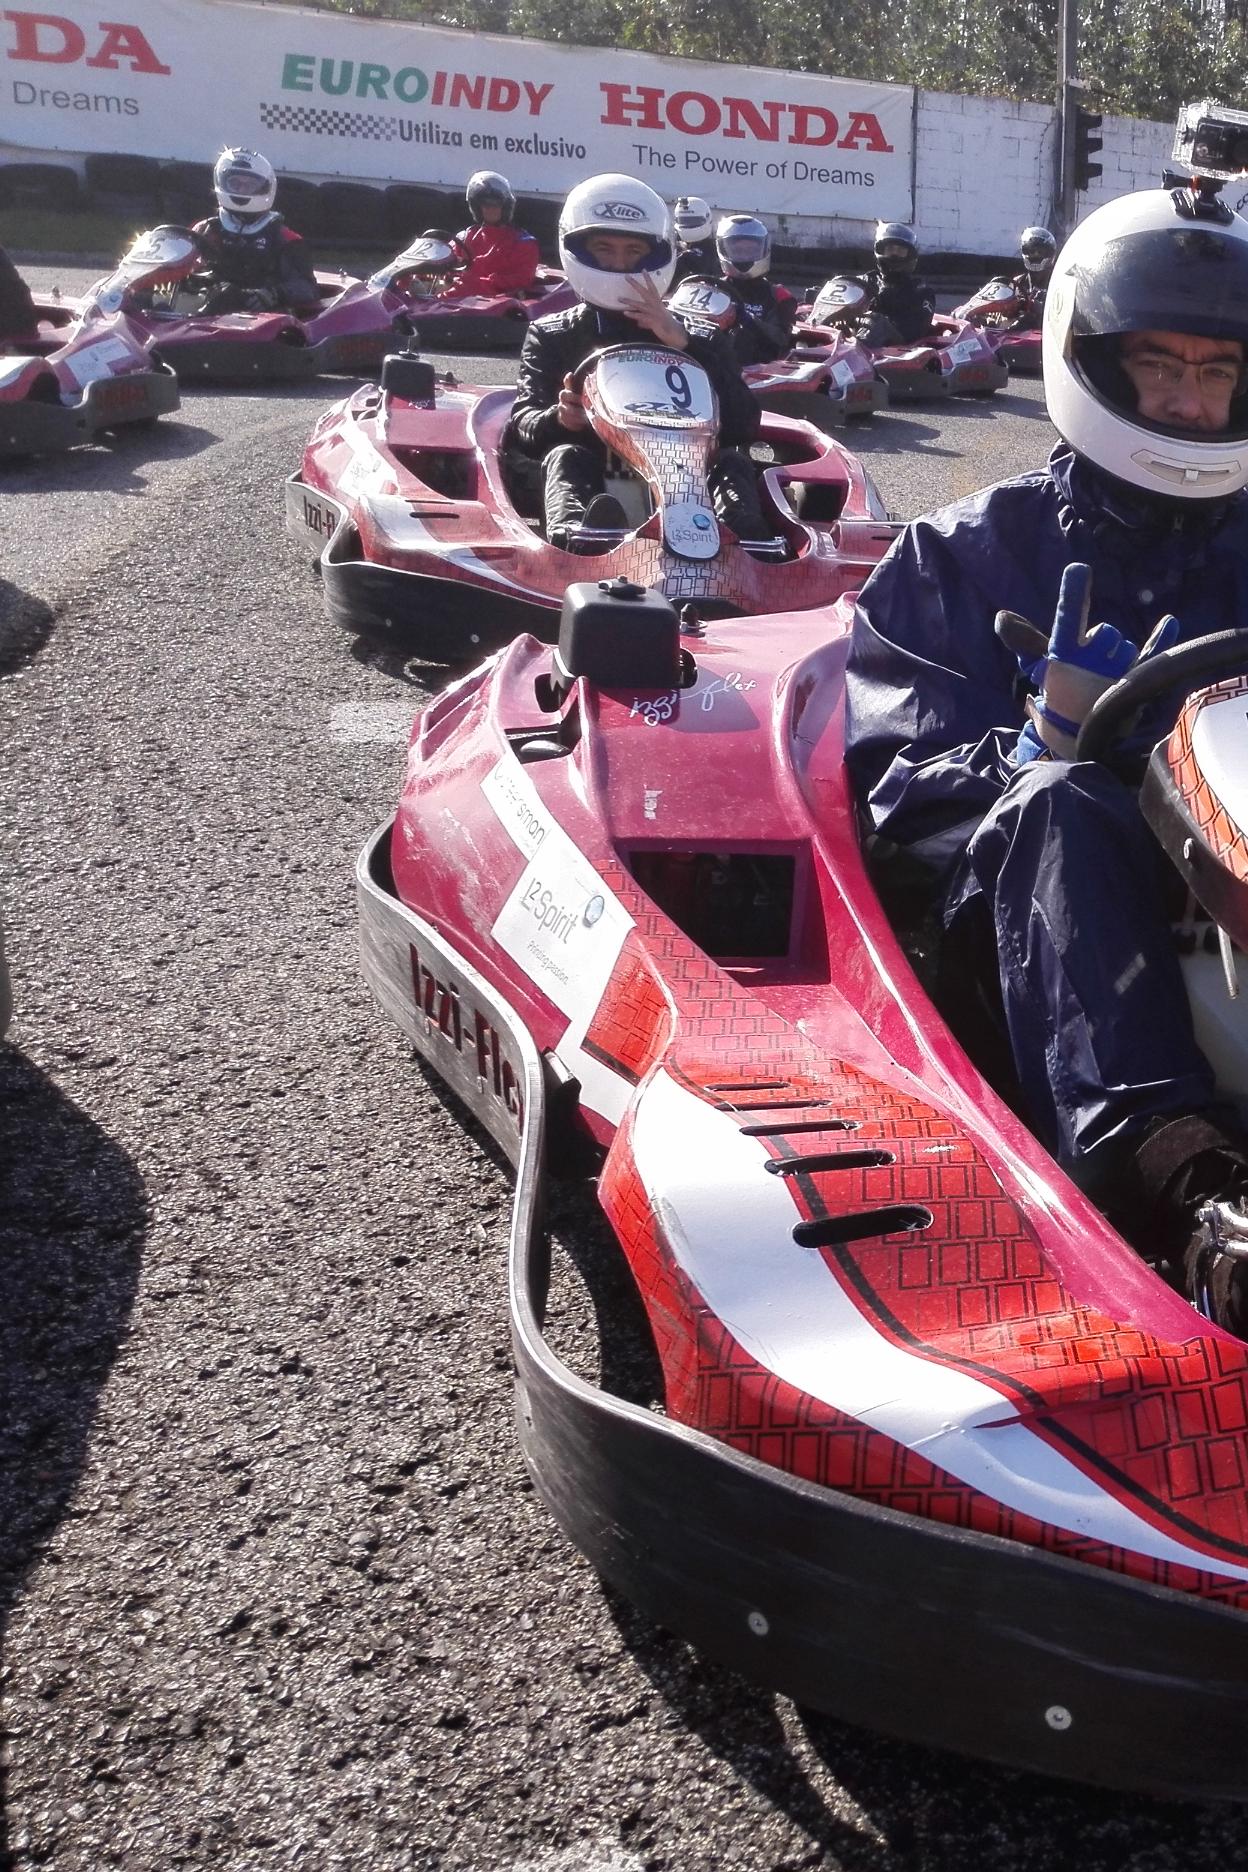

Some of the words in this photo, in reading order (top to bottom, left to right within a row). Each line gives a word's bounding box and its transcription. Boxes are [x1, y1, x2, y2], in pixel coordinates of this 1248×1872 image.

[0, 10, 171, 75] DA
[13, 80, 140, 116] Dreams
[281, 53, 555, 116] EUROINDY
[399, 118, 463, 148] Utiliza
[469, 133, 498, 151] em
[504, 132, 587, 160] exclusivo
[600, 82, 895, 153] HONDA
[632, 144, 677, 169] The
[685, 150, 758, 176] Power
[765, 161, 787, 179] of
[793, 161, 875, 187] Dreams
[688, 288, 713, 309] 14
[829, 284, 847, 298] 2
[665, 365, 692, 409] 9
